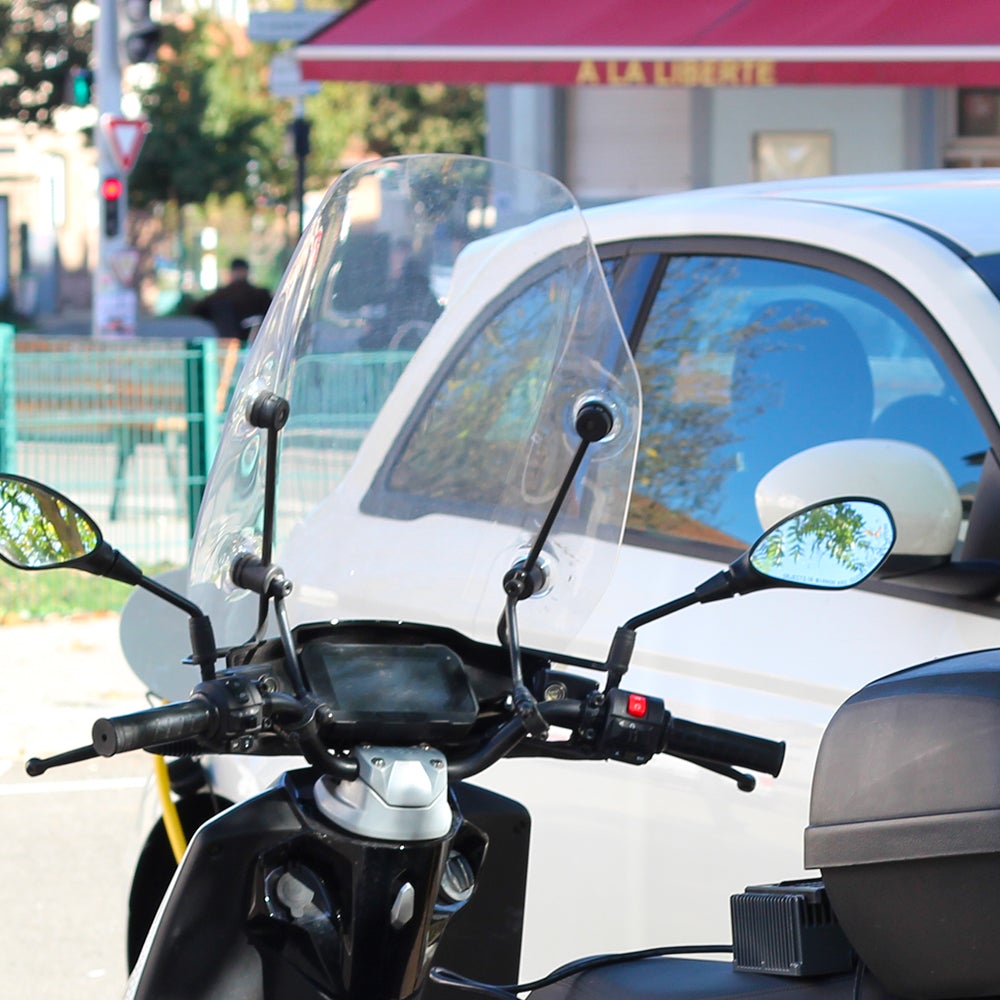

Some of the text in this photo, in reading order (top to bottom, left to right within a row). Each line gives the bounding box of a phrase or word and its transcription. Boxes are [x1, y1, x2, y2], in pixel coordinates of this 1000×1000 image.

[575, 59, 777, 87] A LA LIBERTE
